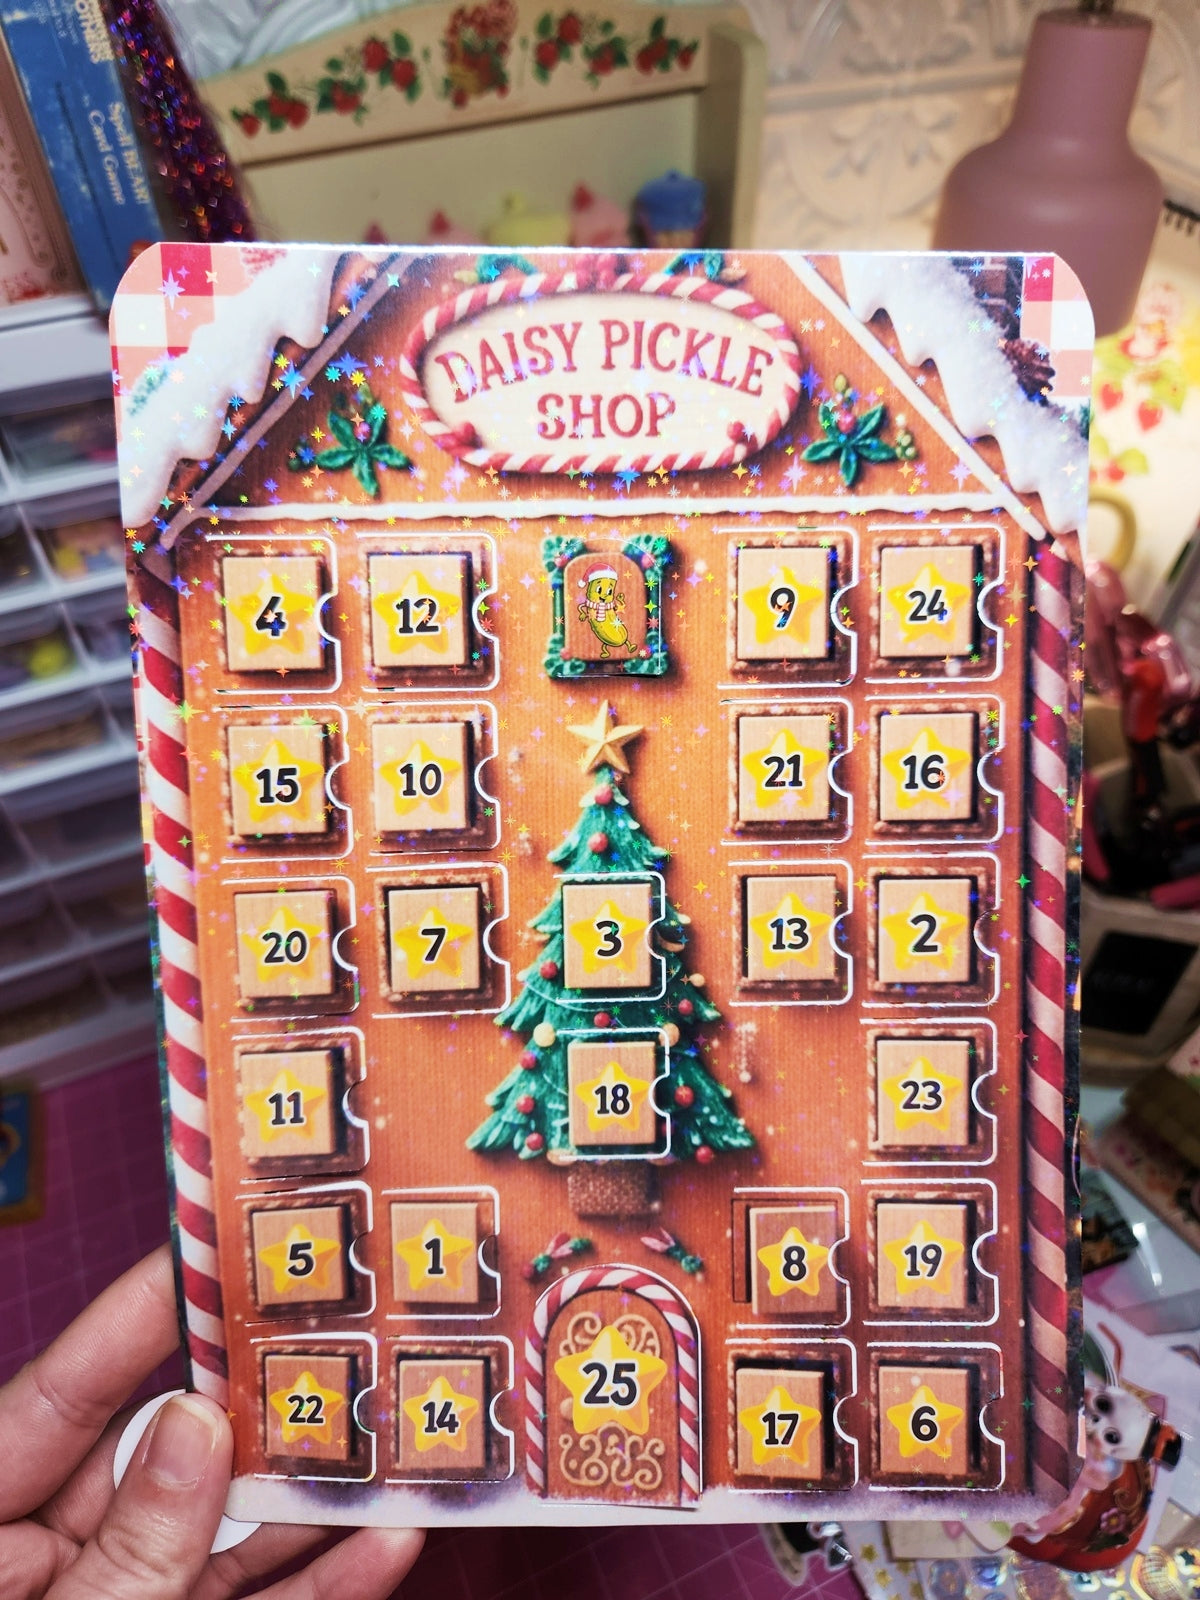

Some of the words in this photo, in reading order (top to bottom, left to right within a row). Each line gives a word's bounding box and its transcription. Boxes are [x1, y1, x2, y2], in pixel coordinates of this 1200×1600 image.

[89, 109, 113, 153] Card
[103, 154, 126, 205] Game
[435, 321, 583, 404] DAISY
[599, 319, 774, 398] PICKLE
[537, 392, 677, 441] SHOP
[255, 596, 286, 637] 4
[395, 598, 439, 634] 12
[769, 586, 796, 629] 9
[907, 588, 948, 622] 24
[256, 767, 299, 804] 15
[399, 763, 442, 796] 10
[764, 754, 803, 788] 21
[903, 754, 944, 790] 16
[262, 930, 307, 964] 20
[421, 927, 446, 961] 7
[596, 920, 622, 957] 3
[770, 917, 809, 950] 13
[911, 914, 938, 953] 2
[268, 1092, 304, 1125] 11
[594, 1083, 630, 1115] 18
[902, 1080, 942, 1111] 23
[288, 1242, 314, 1277] 5
[425, 1238, 444, 1275] 1
[782, 1245, 807, 1282] 8
[904, 1244, 942, 1277] 19
[582, 1362, 637, 1406] 25
[287, 1394, 324, 1424] 22
[423, 1401, 459, 1433] 14
[911, 1405, 938, 1442] 6
[762, 1411, 799, 1445] 17
